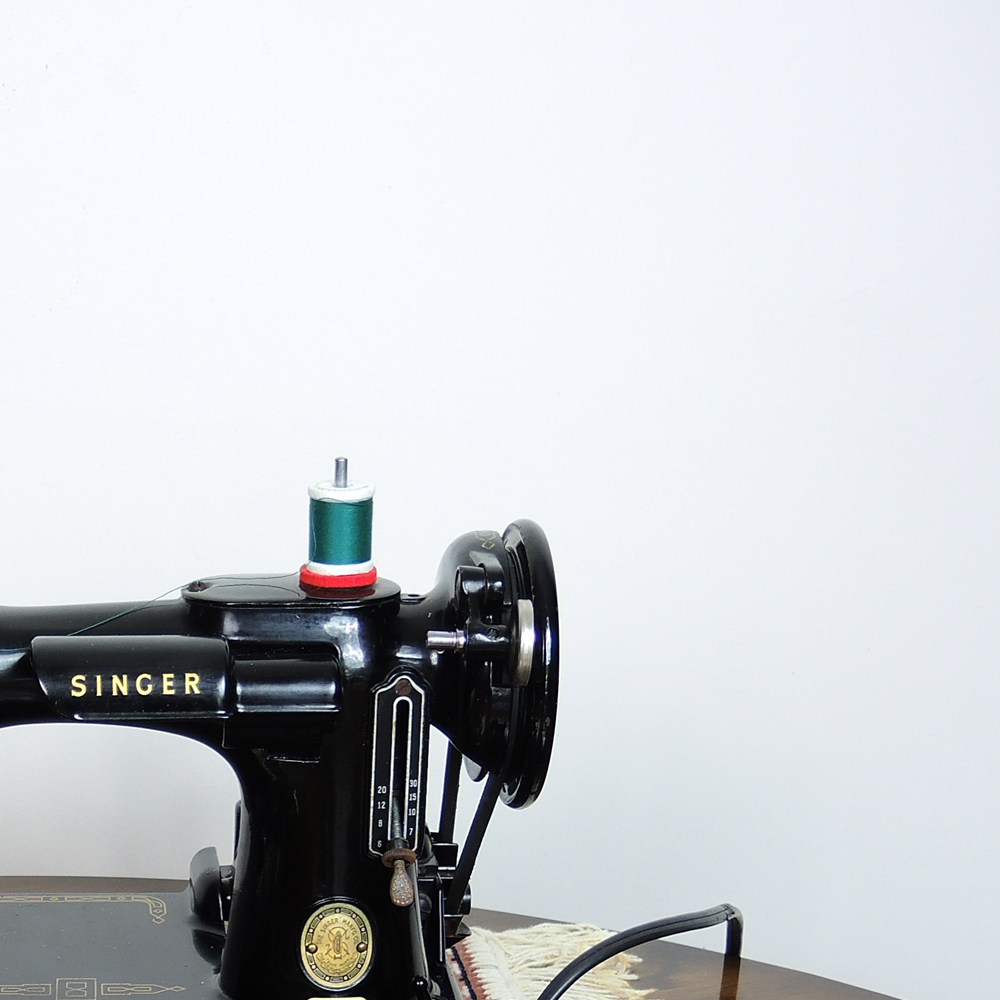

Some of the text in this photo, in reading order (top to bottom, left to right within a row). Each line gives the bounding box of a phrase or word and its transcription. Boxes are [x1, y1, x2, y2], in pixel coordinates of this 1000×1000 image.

[71, 673, 201, 697] SINGER
[409, 779, 418, 788] 30
[377, 785, 387, 794] 20
[409, 792, 417, 801] 15
[377, 801, 386, 809] 12
[408, 808, 416, 816] 10
[378, 819, 383, 828] 8
[408, 827, 414, 836] 7
[377, 840, 383, 848] 6
